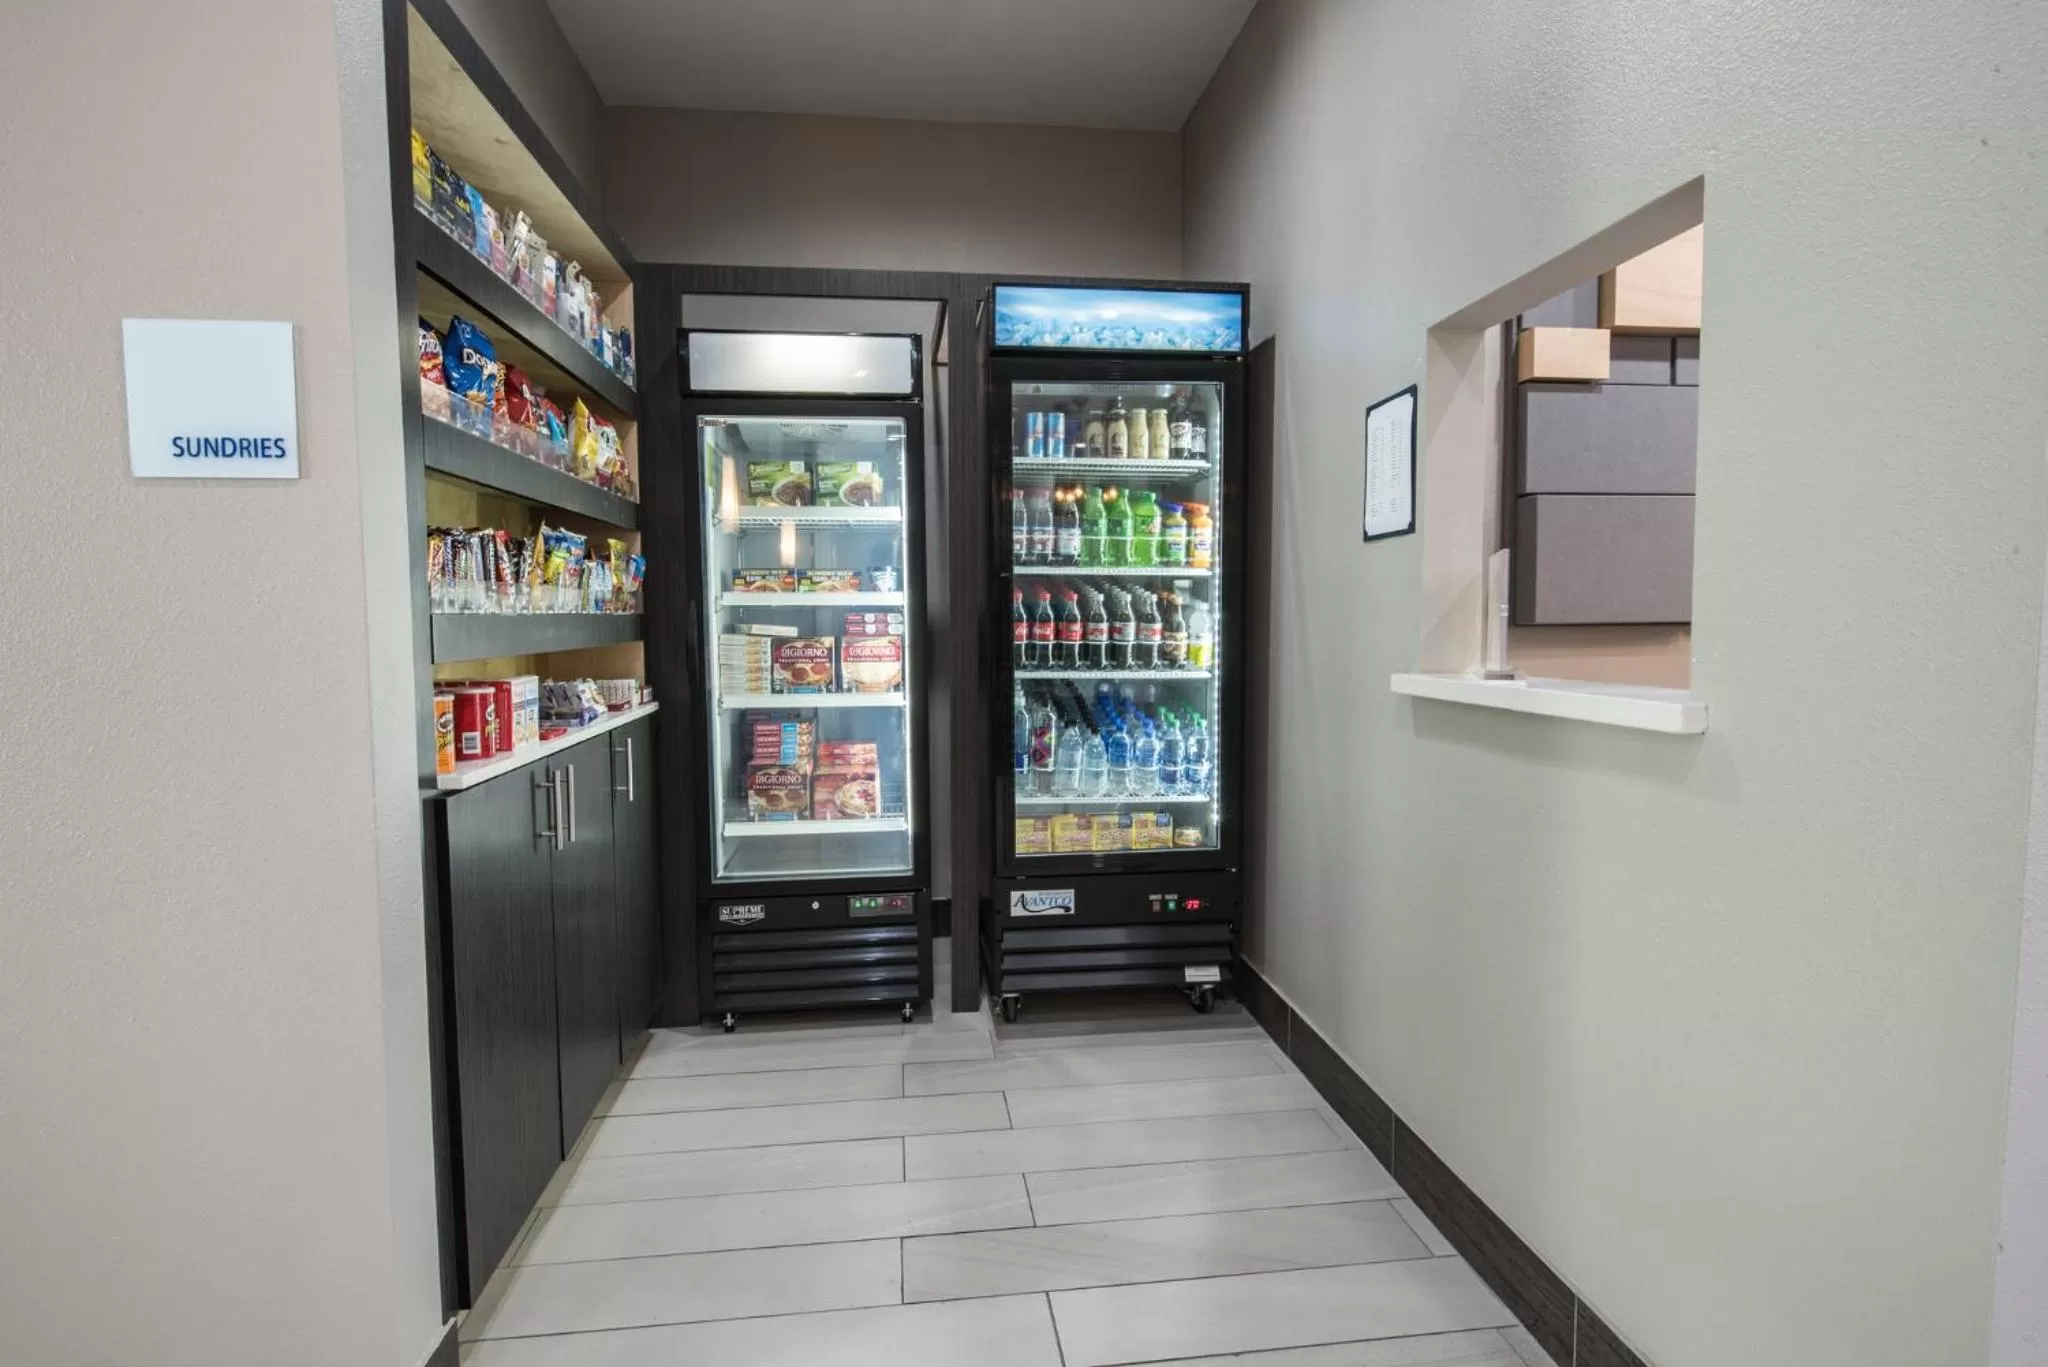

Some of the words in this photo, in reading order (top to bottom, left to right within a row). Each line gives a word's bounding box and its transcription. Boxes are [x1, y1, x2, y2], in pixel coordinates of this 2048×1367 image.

[172, 436, 286, 459] SUNDRIES
[781, 647, 828, 658] DIGIORNO
[849, 647, 895, 657] DIGIORNO
[755, 775, 802, 785] DIGIORNO
[1013, 892, 1072, 912] AVANTCO
